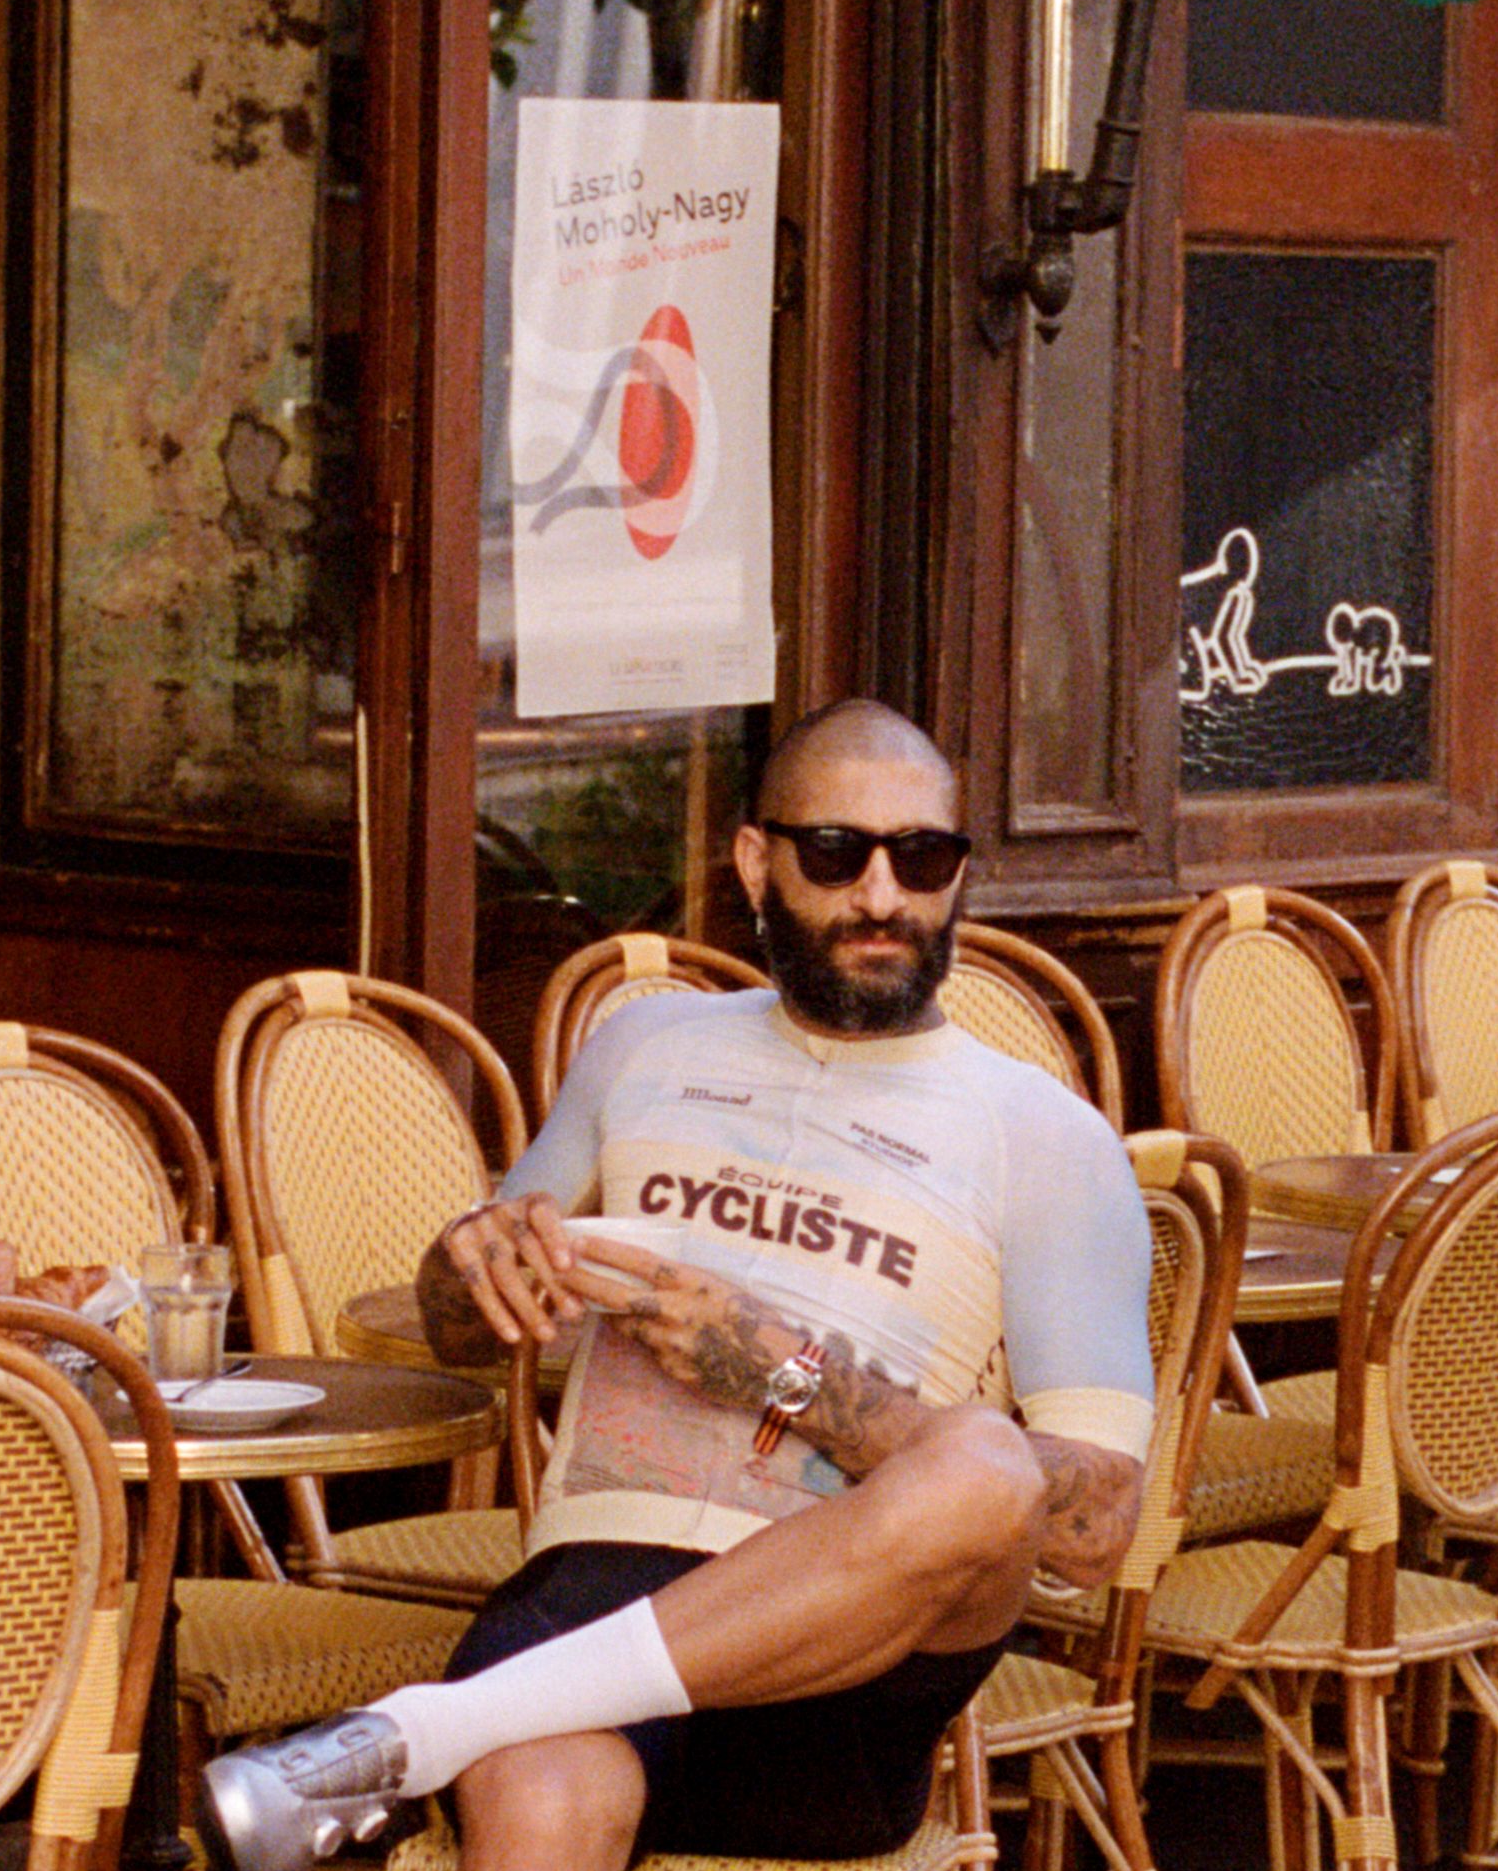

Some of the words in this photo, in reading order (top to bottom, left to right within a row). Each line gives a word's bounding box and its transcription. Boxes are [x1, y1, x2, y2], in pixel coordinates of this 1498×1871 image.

[555, 187, 751, 250] Moholy-Nagy
[717, 1165, 844, 1210] ÉQUIPE
[638, 1172, 917, 1289] CYCLISTE
